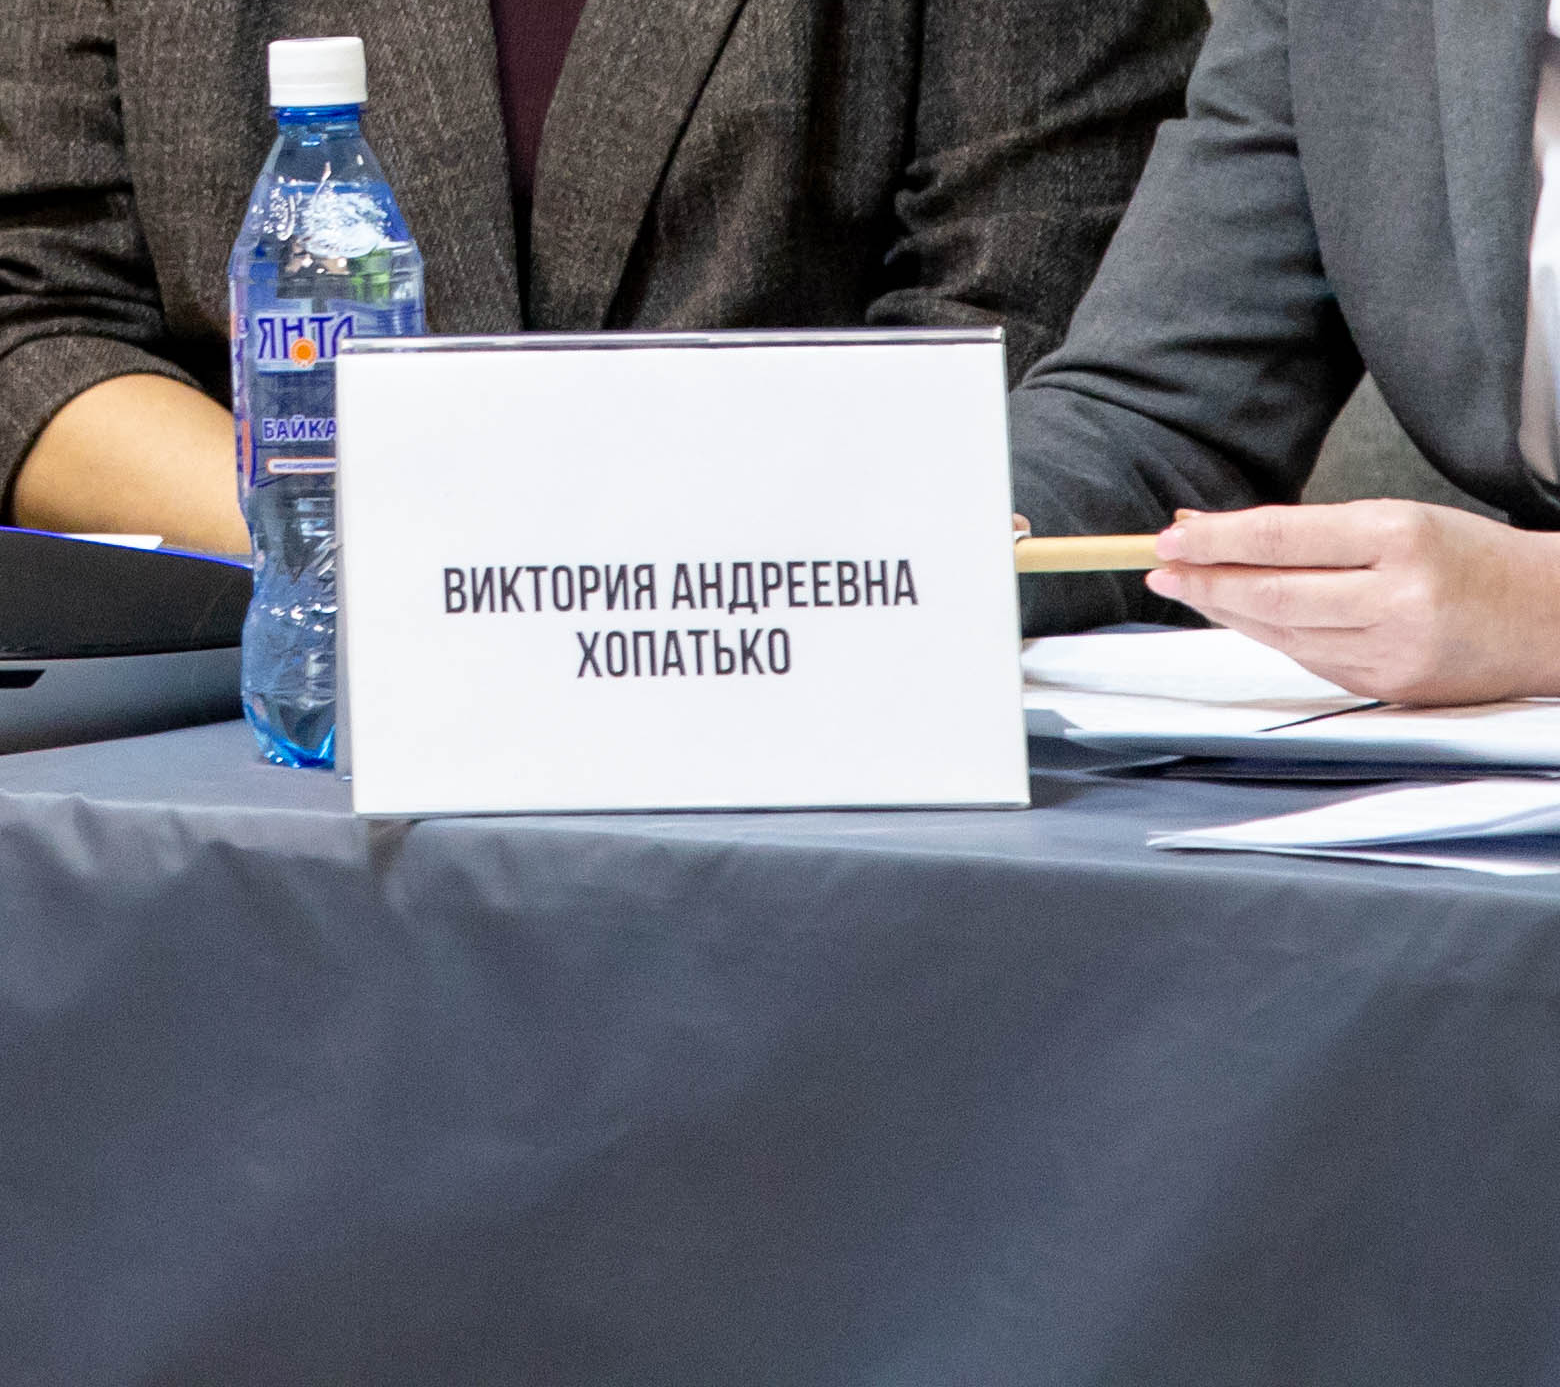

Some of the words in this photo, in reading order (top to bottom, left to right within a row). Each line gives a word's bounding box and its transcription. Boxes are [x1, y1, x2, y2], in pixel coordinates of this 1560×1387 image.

[443, 563, 658, 614] ВИКТОРИЯ
[671, 558, 919, 616] АНДРЕЕВНА
[575, 627, 793, 679] ХОПАТЬКО
